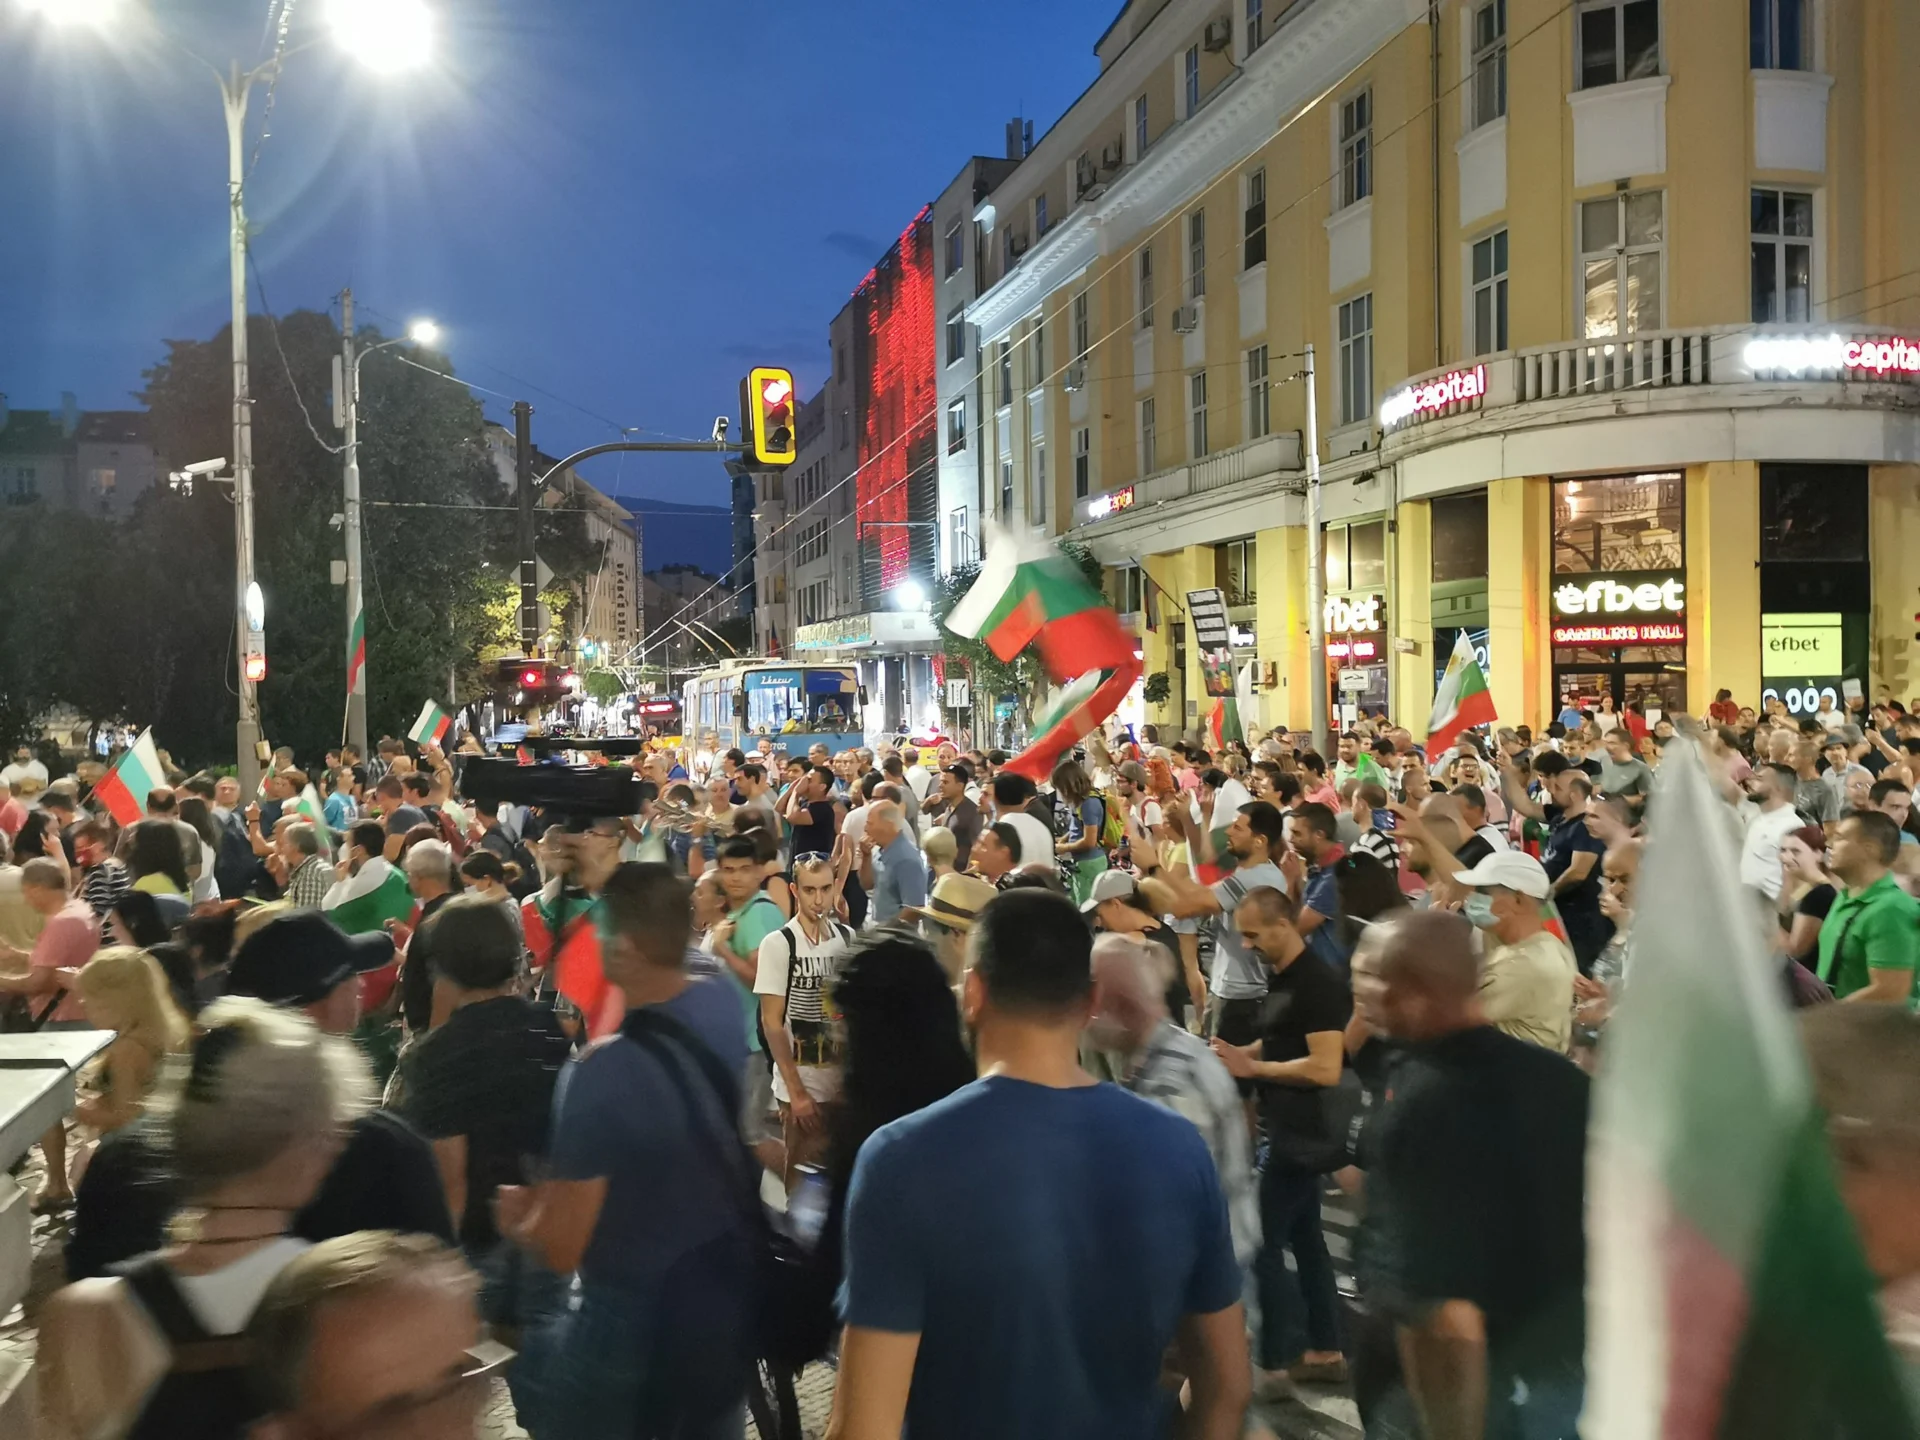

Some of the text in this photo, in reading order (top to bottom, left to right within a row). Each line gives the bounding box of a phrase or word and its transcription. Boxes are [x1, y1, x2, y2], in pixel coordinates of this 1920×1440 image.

[1841, 337, 1920, 375] capita
[1553, 577, 1685, 614] efbet
[1323, 594, 1380, 633] fbet
[1553, 625, 1684, 642] GAMBLING HALL
[1769, 636, 1820, 652] efbet
[759, 726, 766, 735] 9
[792, 956, 835, 977] SUMM
[792, 977, 820, 988] VIBE
